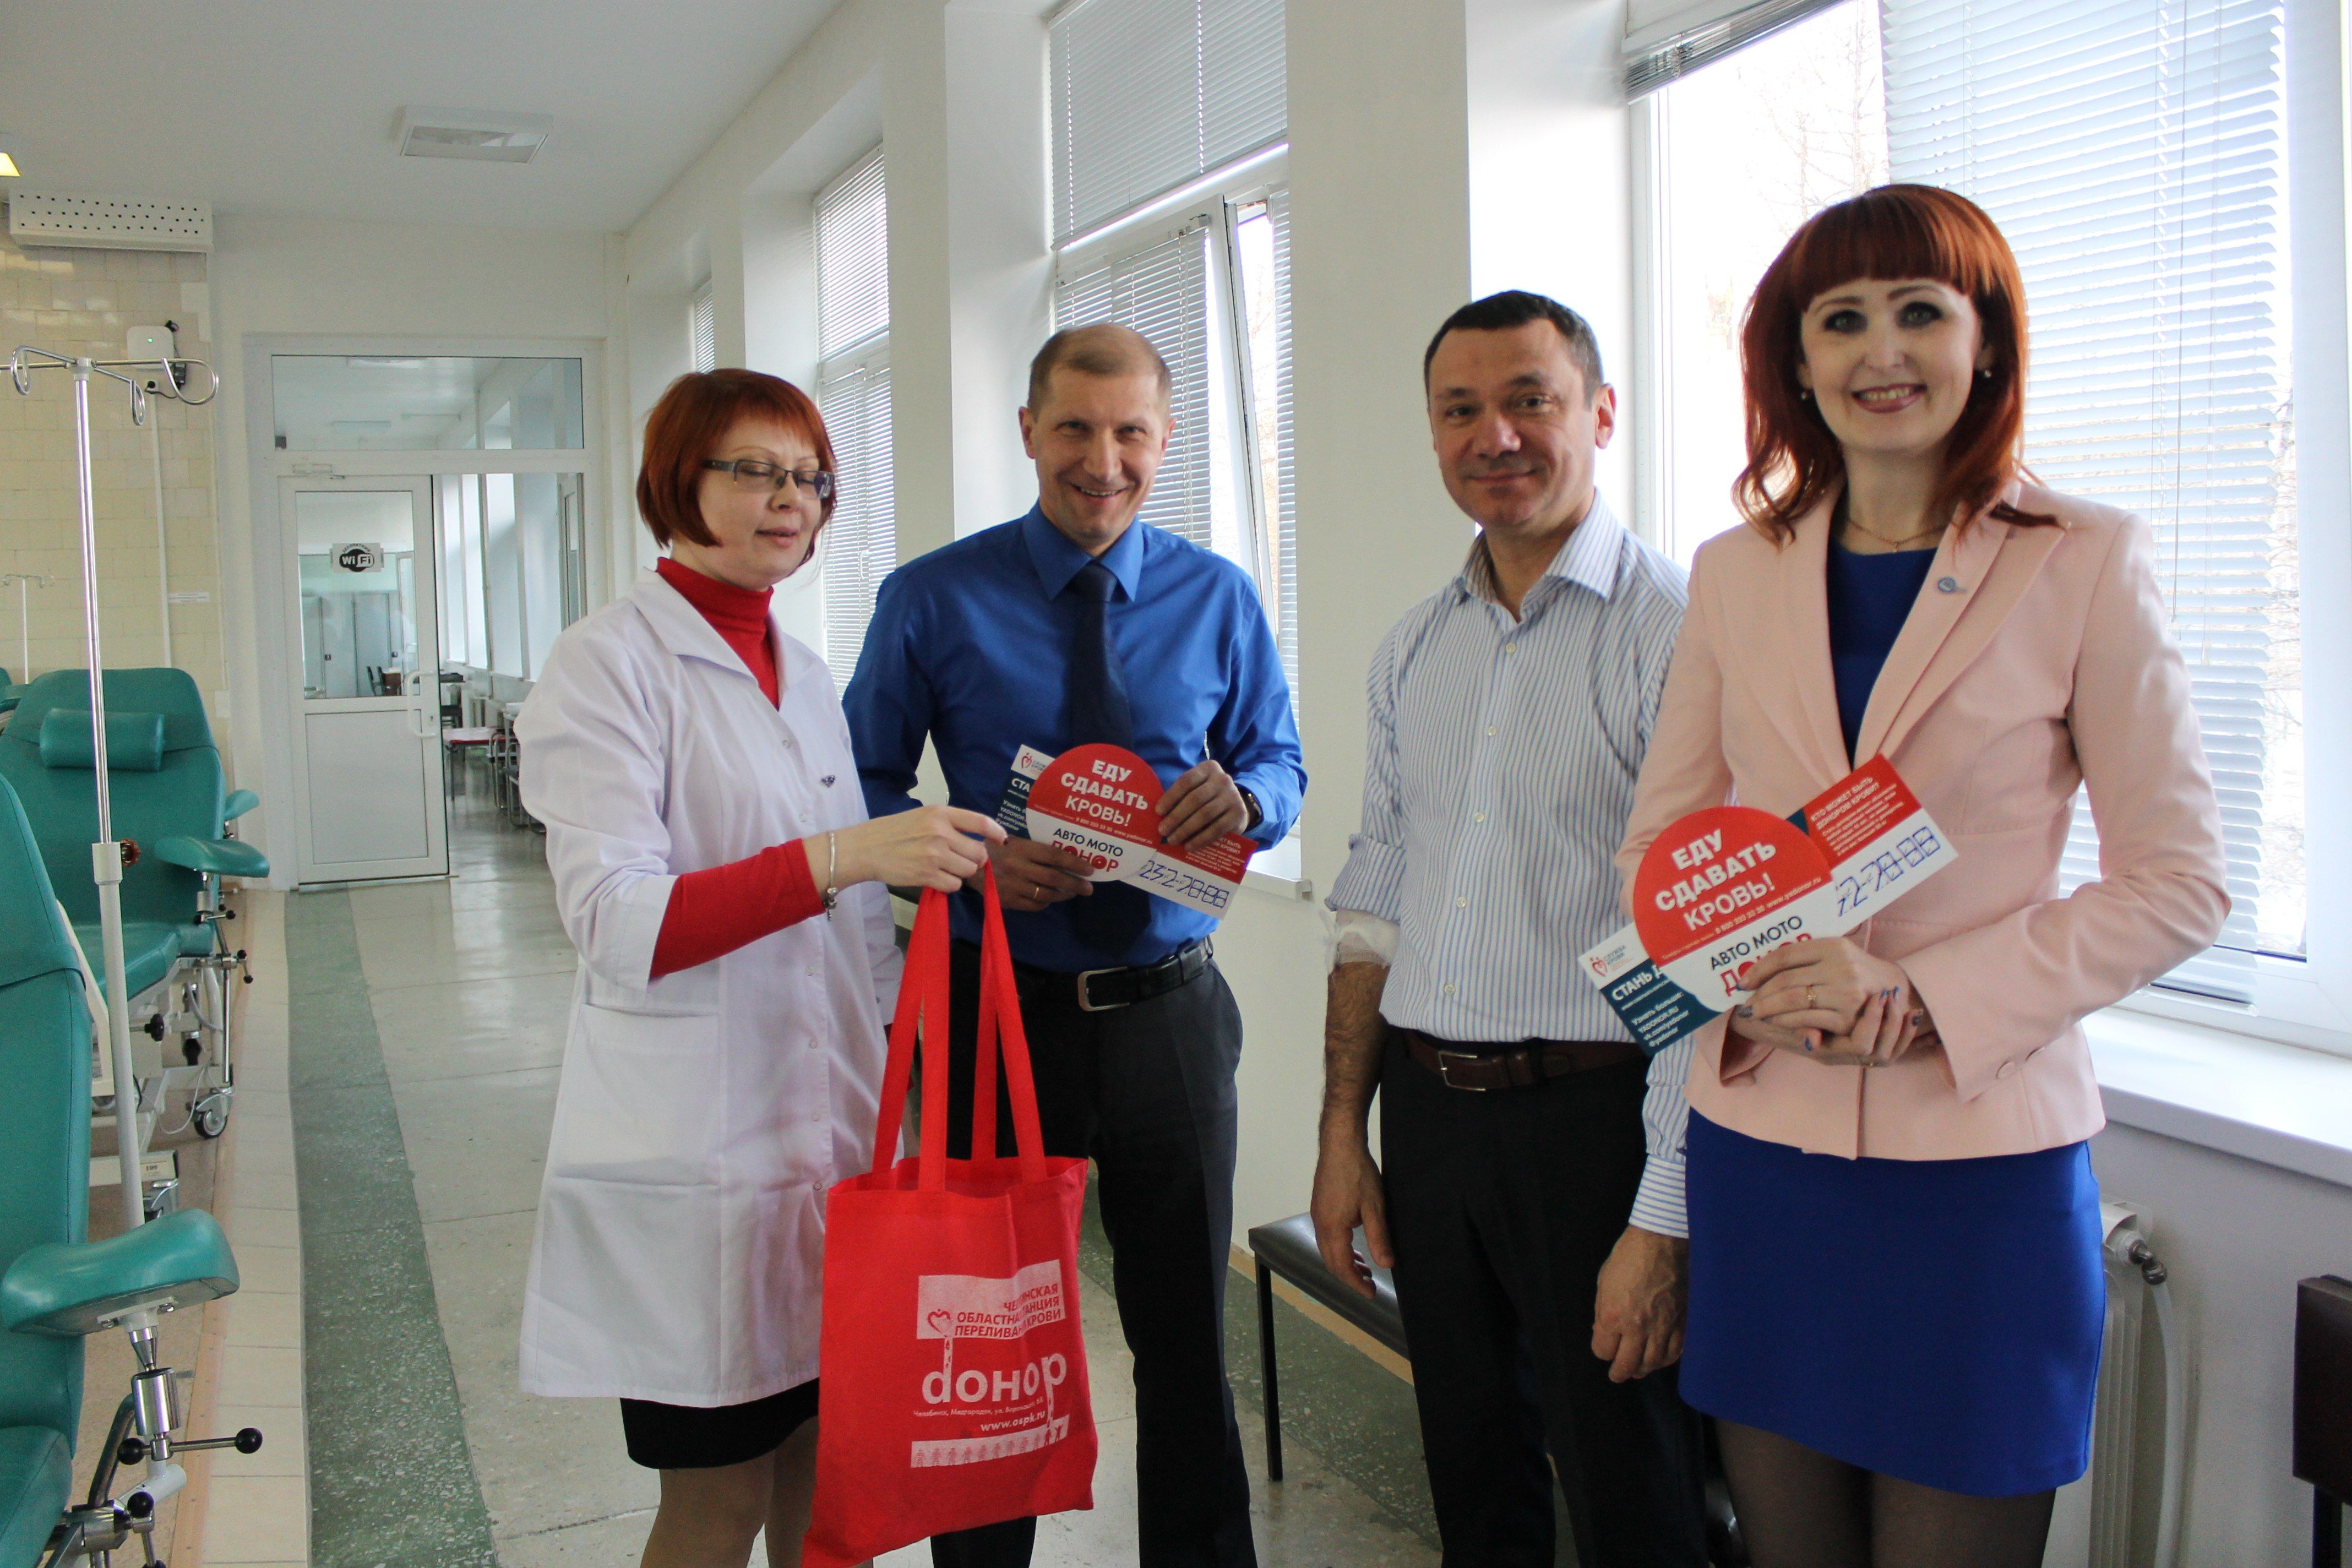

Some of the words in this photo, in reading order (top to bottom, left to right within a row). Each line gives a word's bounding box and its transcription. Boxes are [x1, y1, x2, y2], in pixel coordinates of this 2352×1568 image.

[1011, 777, 1030, 792] СТА
[1092, 759, 1132, 782] ЕДУ
[1060, 772, 1148, 810] СДАВАТЬ
[1065, 795, 1131, 827] КРОВЬ!
[1053, 828, 1085, 845] АВТО
[1086, 839, 1123, 857] МОТО
[1672, 829, 1723, 870] ЕДУ
[1656, 842, 1777, 911] СДАВАТЬ
[1683, 872, 1776, 932] КРОВЬ!
[1711, 942, 1750, 971] АВТО
[1752, 916, 1802, 949] МОТО
[1612, 971, 1653, 1001] СТАНЬ
[957, 1312, 1020, 1325] ОБЛАСТНА
[980, 1410, 1046, 1432] www.ospk.ru
